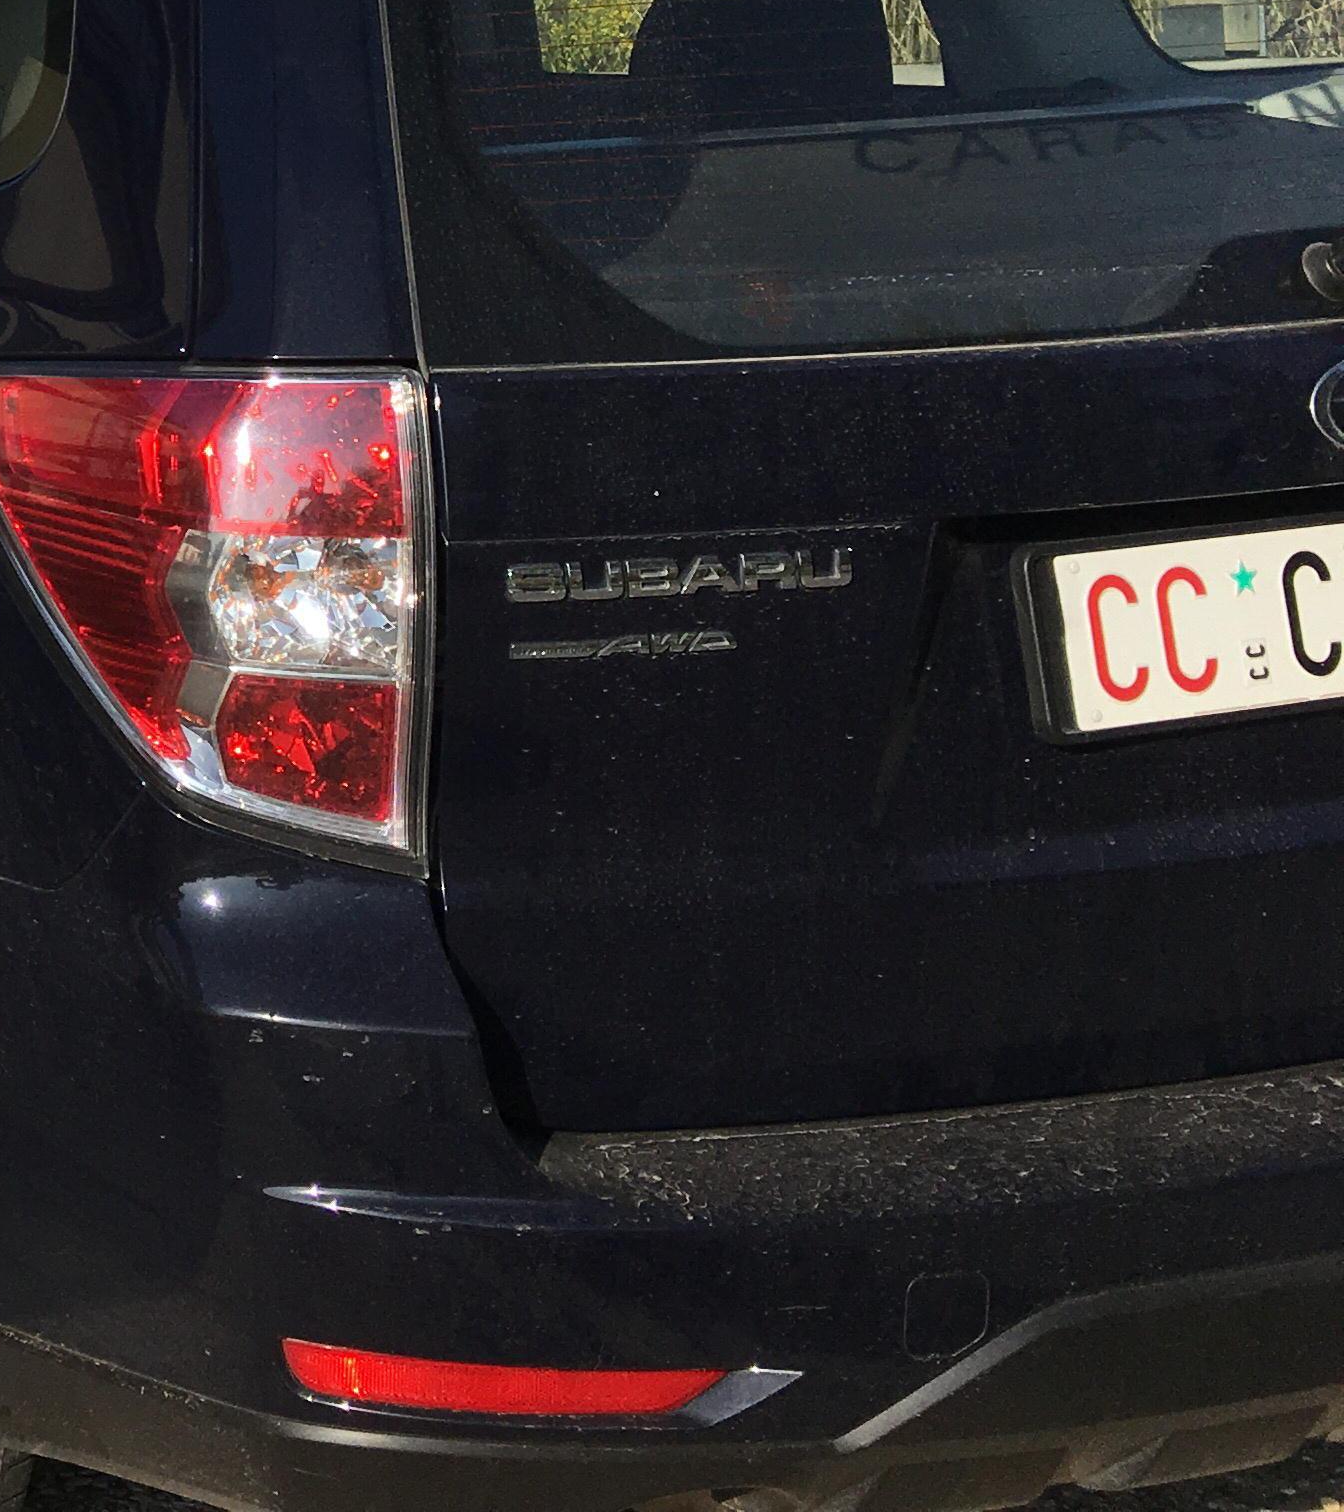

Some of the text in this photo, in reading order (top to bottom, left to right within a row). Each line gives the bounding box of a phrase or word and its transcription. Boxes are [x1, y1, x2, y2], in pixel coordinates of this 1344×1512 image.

[507, 549, 853, 603] SUBARU
[1087, 550, 1342, 702] CC C
